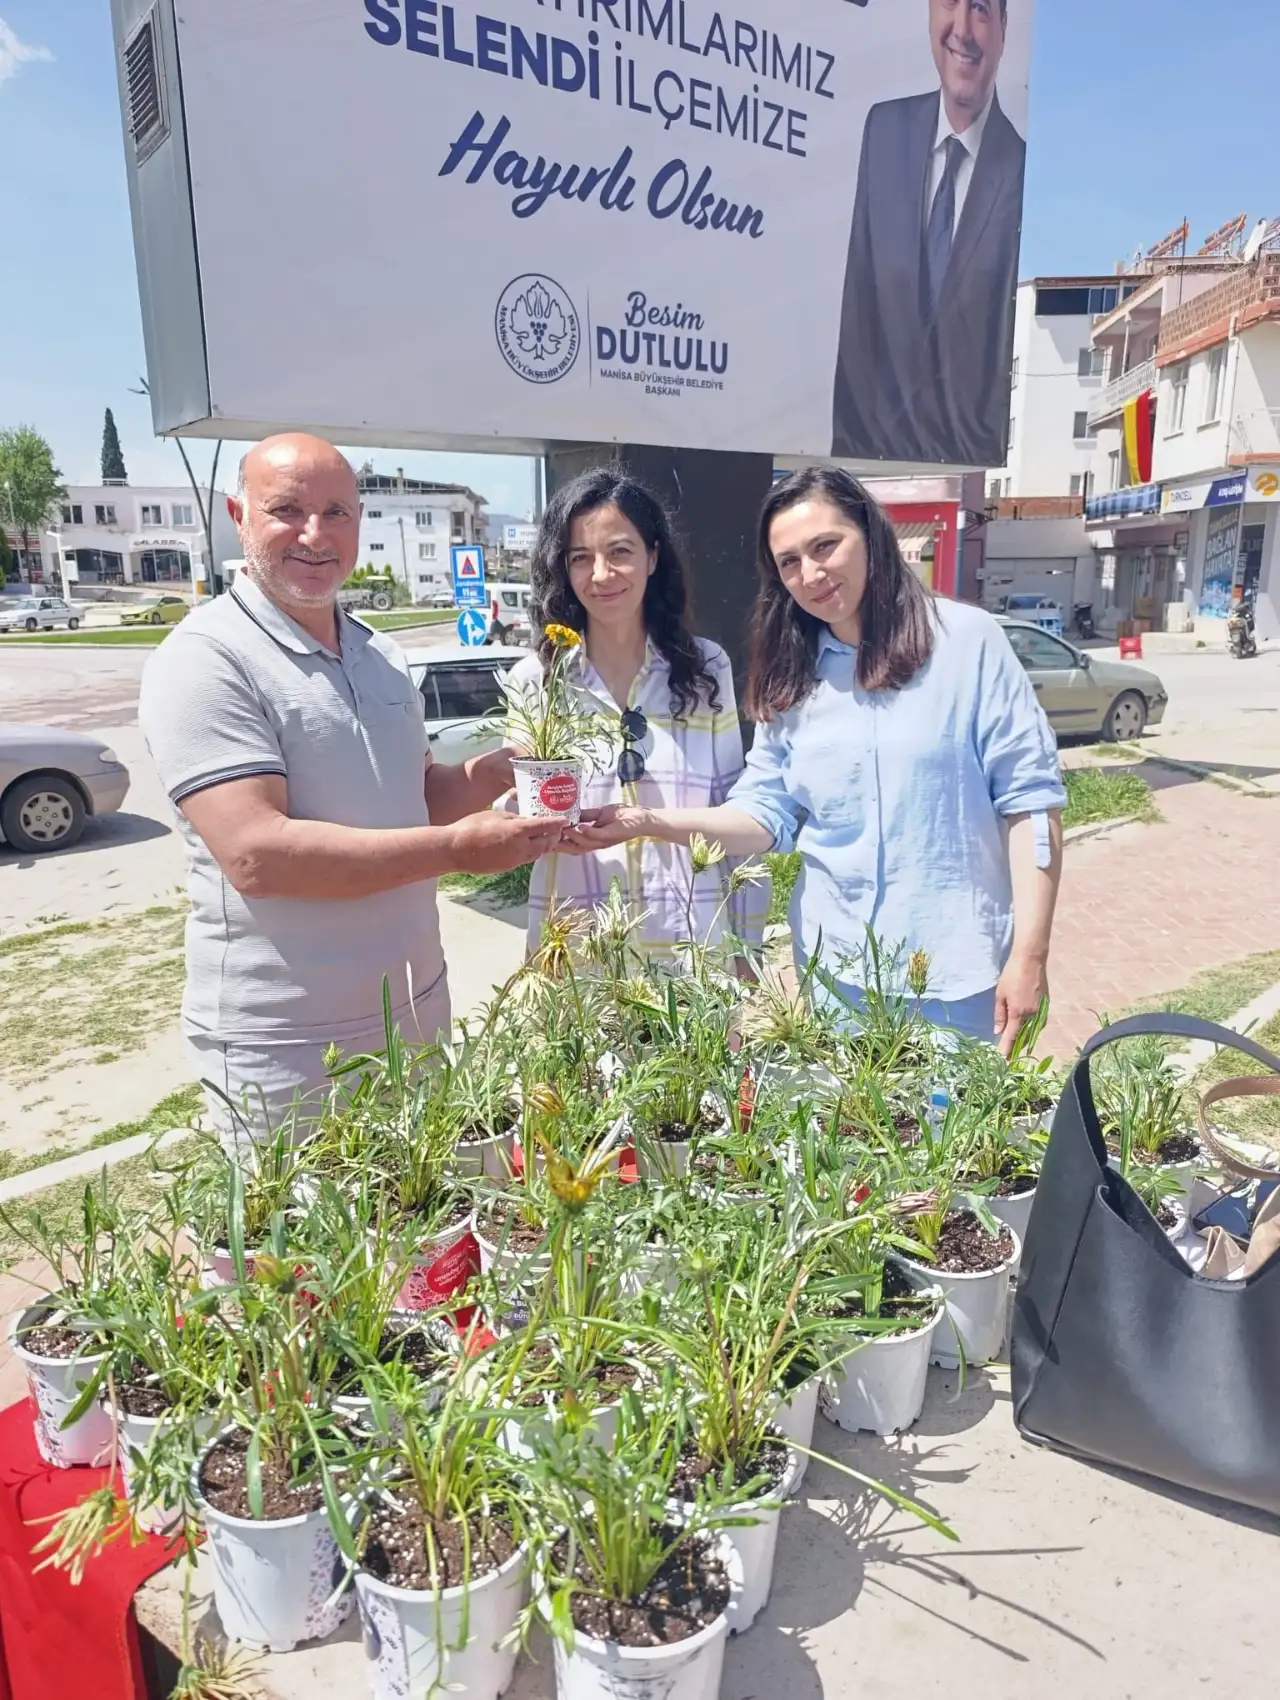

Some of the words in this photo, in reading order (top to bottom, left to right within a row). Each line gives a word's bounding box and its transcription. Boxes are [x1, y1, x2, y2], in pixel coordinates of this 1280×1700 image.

[536, 0, 836, 99] RIMLARIMIZ
[363, 0, 600, 101] SELENDİ
[614, 41, 808, 158] İLÇEMİZE
[438, 110, 634, 219] Hayırlı
[646, 158, 764, 239] Olsun
[624, 290, 705, 331] Besim
[596, 325, 729, 375] DUTLULU
[600, 368, 633, 381] MANİSA
[634, 370, 685, 387] BÜYÜKŞEHİR
[686, 378, 724, 391] BELEDİYE
[645, 384, 681, 397] BAŞKANI
